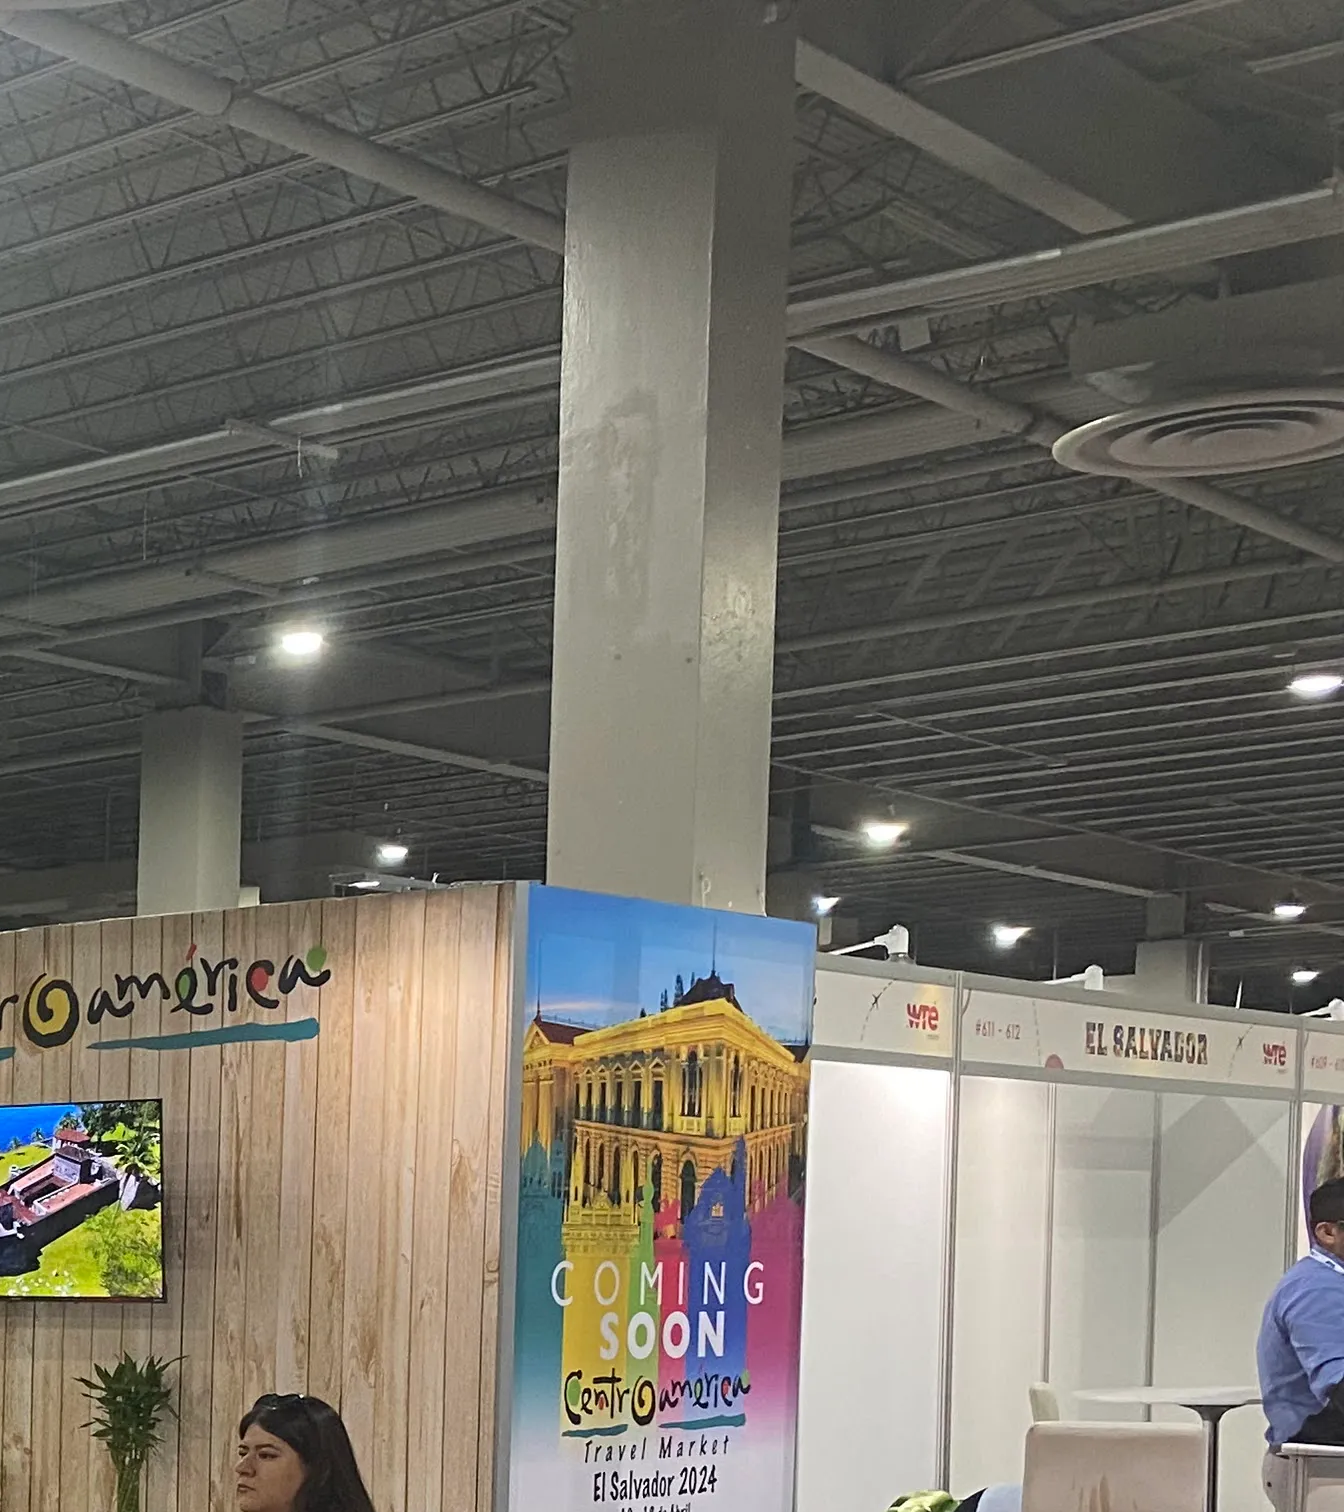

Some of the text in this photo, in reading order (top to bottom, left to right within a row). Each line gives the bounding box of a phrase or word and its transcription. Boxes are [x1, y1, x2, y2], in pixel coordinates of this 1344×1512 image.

[1085, 1021, 1208, 1065] EL SALVADOR
[551, 1261, 765, 1307] COMING
[599, 1311, 726, 1359] SOON
[564, 1366, 751, 1426] Centroamérica
[584, 1434, 730, 1463] Travel Market
[593, 1464, 718, 1502] El Salvador 2024
